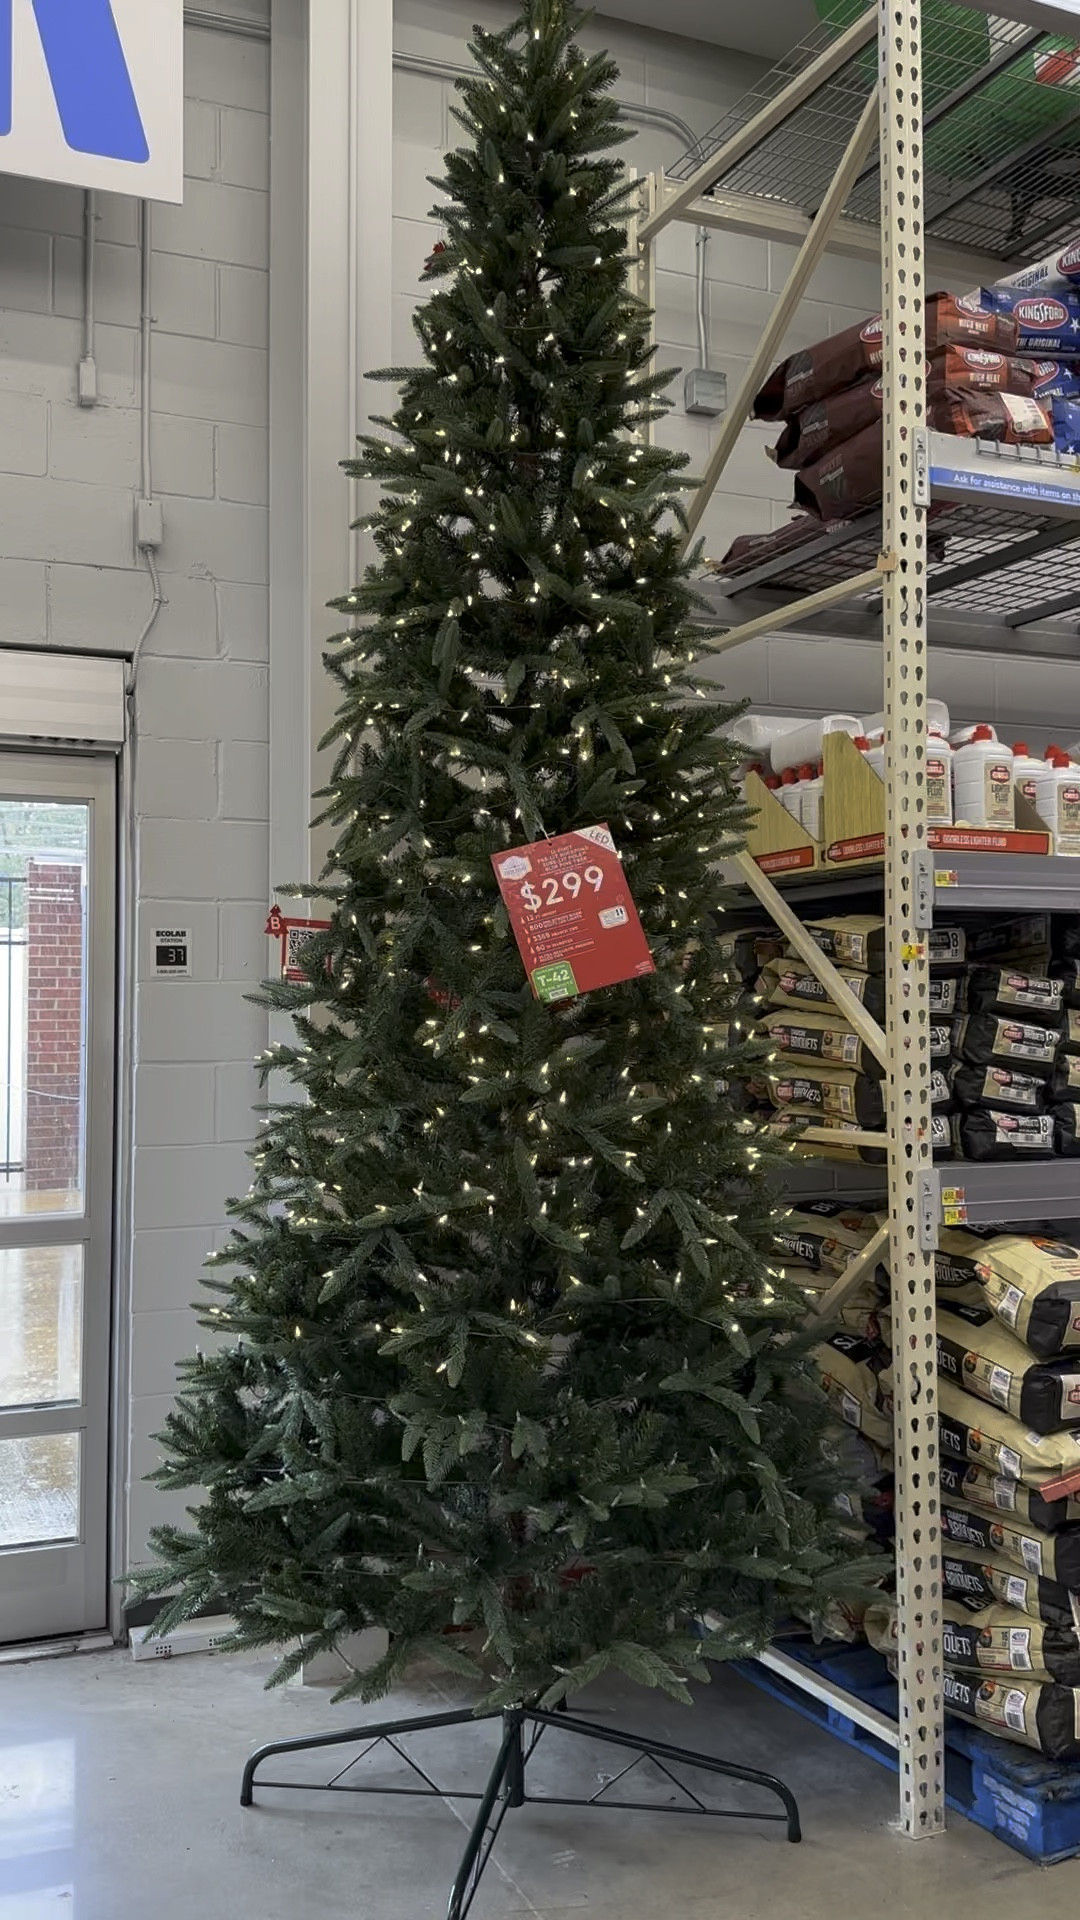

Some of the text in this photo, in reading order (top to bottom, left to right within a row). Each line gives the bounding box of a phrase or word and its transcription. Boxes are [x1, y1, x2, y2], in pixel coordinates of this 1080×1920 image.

[1018, 302, 1065, 323] KINGSFORD
[1028, 338, 1061, 349] ORIGINAL
[953, 473, 968, 482] Ask
[970, 477, 981, 485] for
[983, 479, 1021, 492] assistance
[1022, 484, 1038, 495] with
[1039, 488, 1060, 498] items
[1061, 491, 1071, 499] on
[589, 829, 611, 845] LED
[520, 865, 604, 913] $299
[270, 916, 281, 930] B
[950, 932, 959, 948] 8
[537, 970, 570, 987] T-42
[943, 983, 950, 998] 8
[790, 1035, 819, 1051] BRIQUETS
[1041, 1118, 1048, 1133] 8
[935, 1263, 975, 1281] RIQUETS
[945, 1570, 985, 1593] BRIQUETS
[943, 1633, 972, 1656] QUETS
[943, 1678, 970, 1704] QUETS
